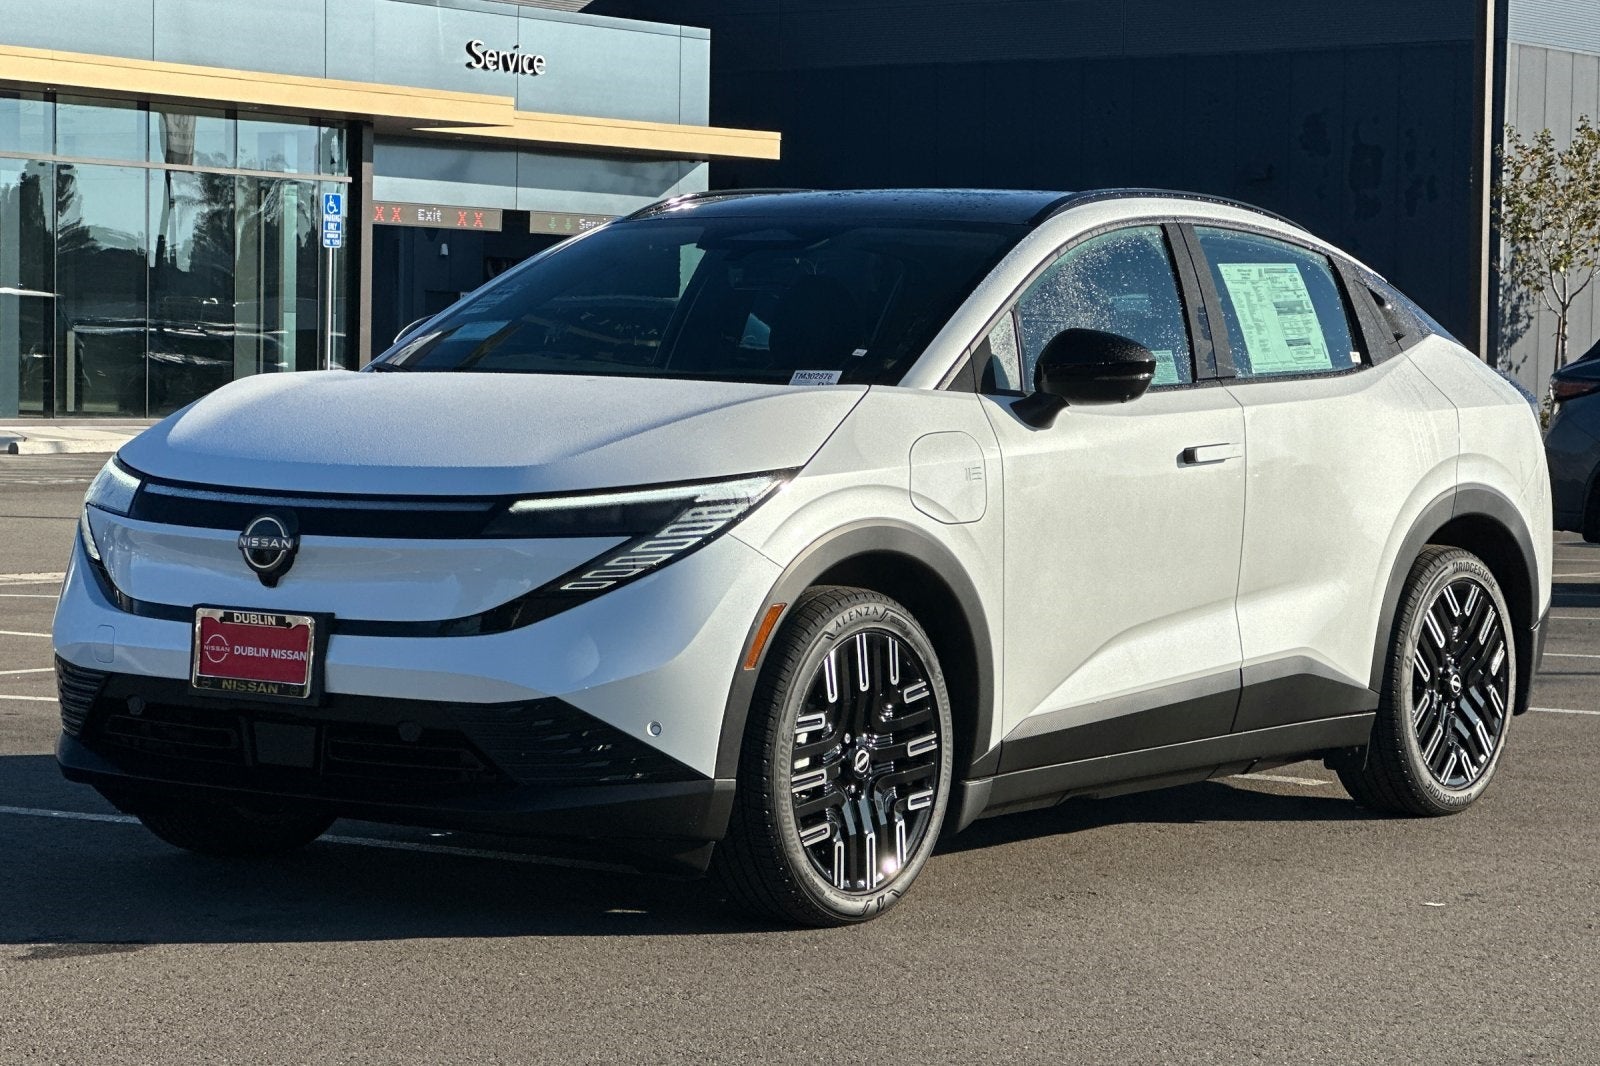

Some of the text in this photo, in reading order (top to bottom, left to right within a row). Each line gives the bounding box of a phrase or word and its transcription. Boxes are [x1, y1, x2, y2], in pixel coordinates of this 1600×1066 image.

[467, 39, 546, 75] Service
[417, 207, 442, 222] Exit
[239, 537, 292, 549] NISSAN
[233, 612, 276, 626] DUBLIN
[834, 606, 879, 631] ALENZA
[204, 644, 230, 653] NISSAN
[234, 645, 307, 661] DUBLIN NISSAN
[221, 679, 279, 694] NISSAN
